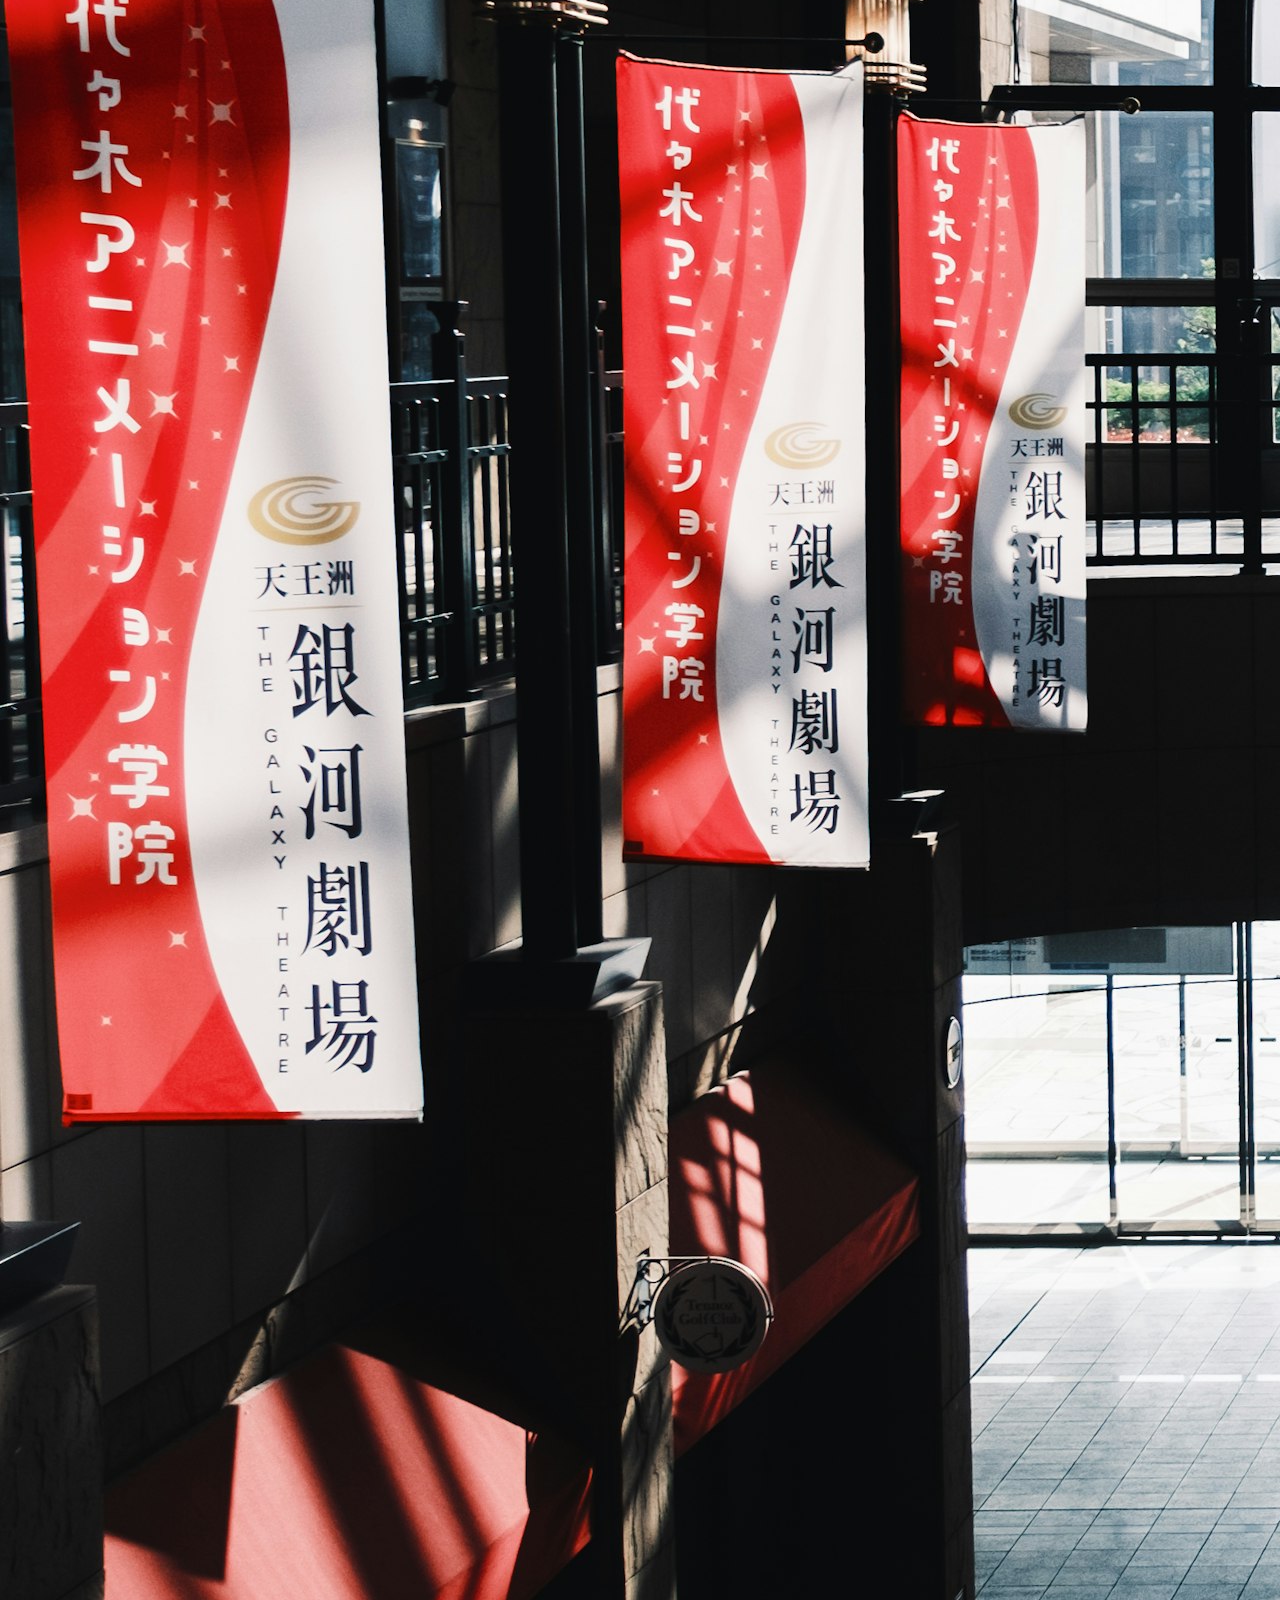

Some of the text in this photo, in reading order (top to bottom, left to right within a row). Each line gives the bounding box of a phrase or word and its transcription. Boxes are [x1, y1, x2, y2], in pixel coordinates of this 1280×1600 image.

[655, 86, 705, 702] 代々木アニメーション学院
[926, 138, 963, 605] 代々木アニメーション学院
[1011, 438, 1064, 457] 天王洲
[256, 560, 355, 598] 天王洲
[768, 480, 835, 506] 天王洲
[1010, 471, 1020, 707] THE GALAXY THEATRE
[1024, 470, 1068, 707] 銀河劇場
[768, 525, 782, 835] THE GALAXY THEATRE
[788, 523, 845, 834] 銀河劇場
[257, 626, 289, 1073] THE GALAXY THEATRE
[287, 622, 379, 1073] 銀河劇場
[679, 1312, 741, 1325] Golf Club
[685, 1299, 735, 1311] Tennoz
